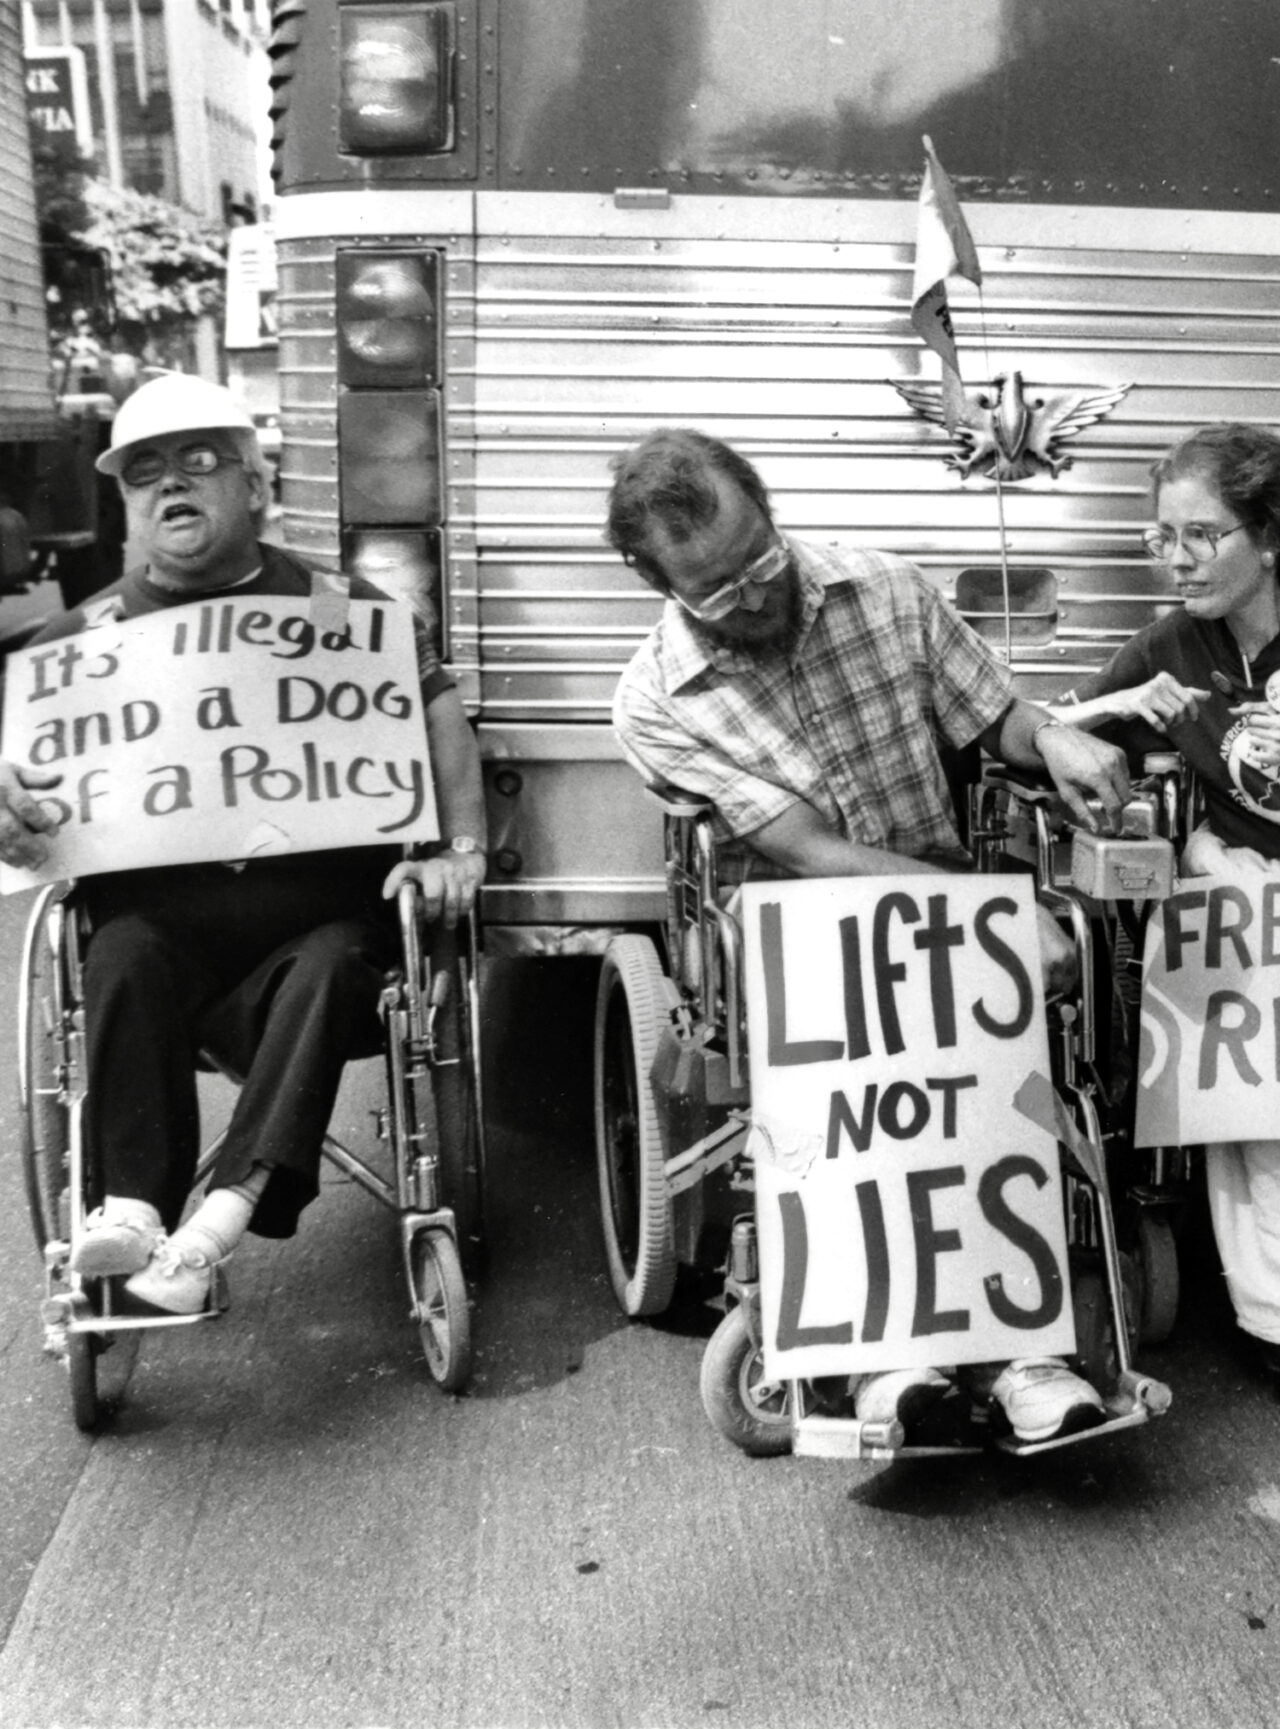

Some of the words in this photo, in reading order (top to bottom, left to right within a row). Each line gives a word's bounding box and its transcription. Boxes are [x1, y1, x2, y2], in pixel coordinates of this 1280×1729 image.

[197, 687, 243, 730] a
[278, 676, 412, 724] DOG
[143, 765, 194, 817] a
[220, 742, 423, 833] Policy
[826, 1074, 978, 1159] NOT
[776, 1155, 1063, 1351] LIES
